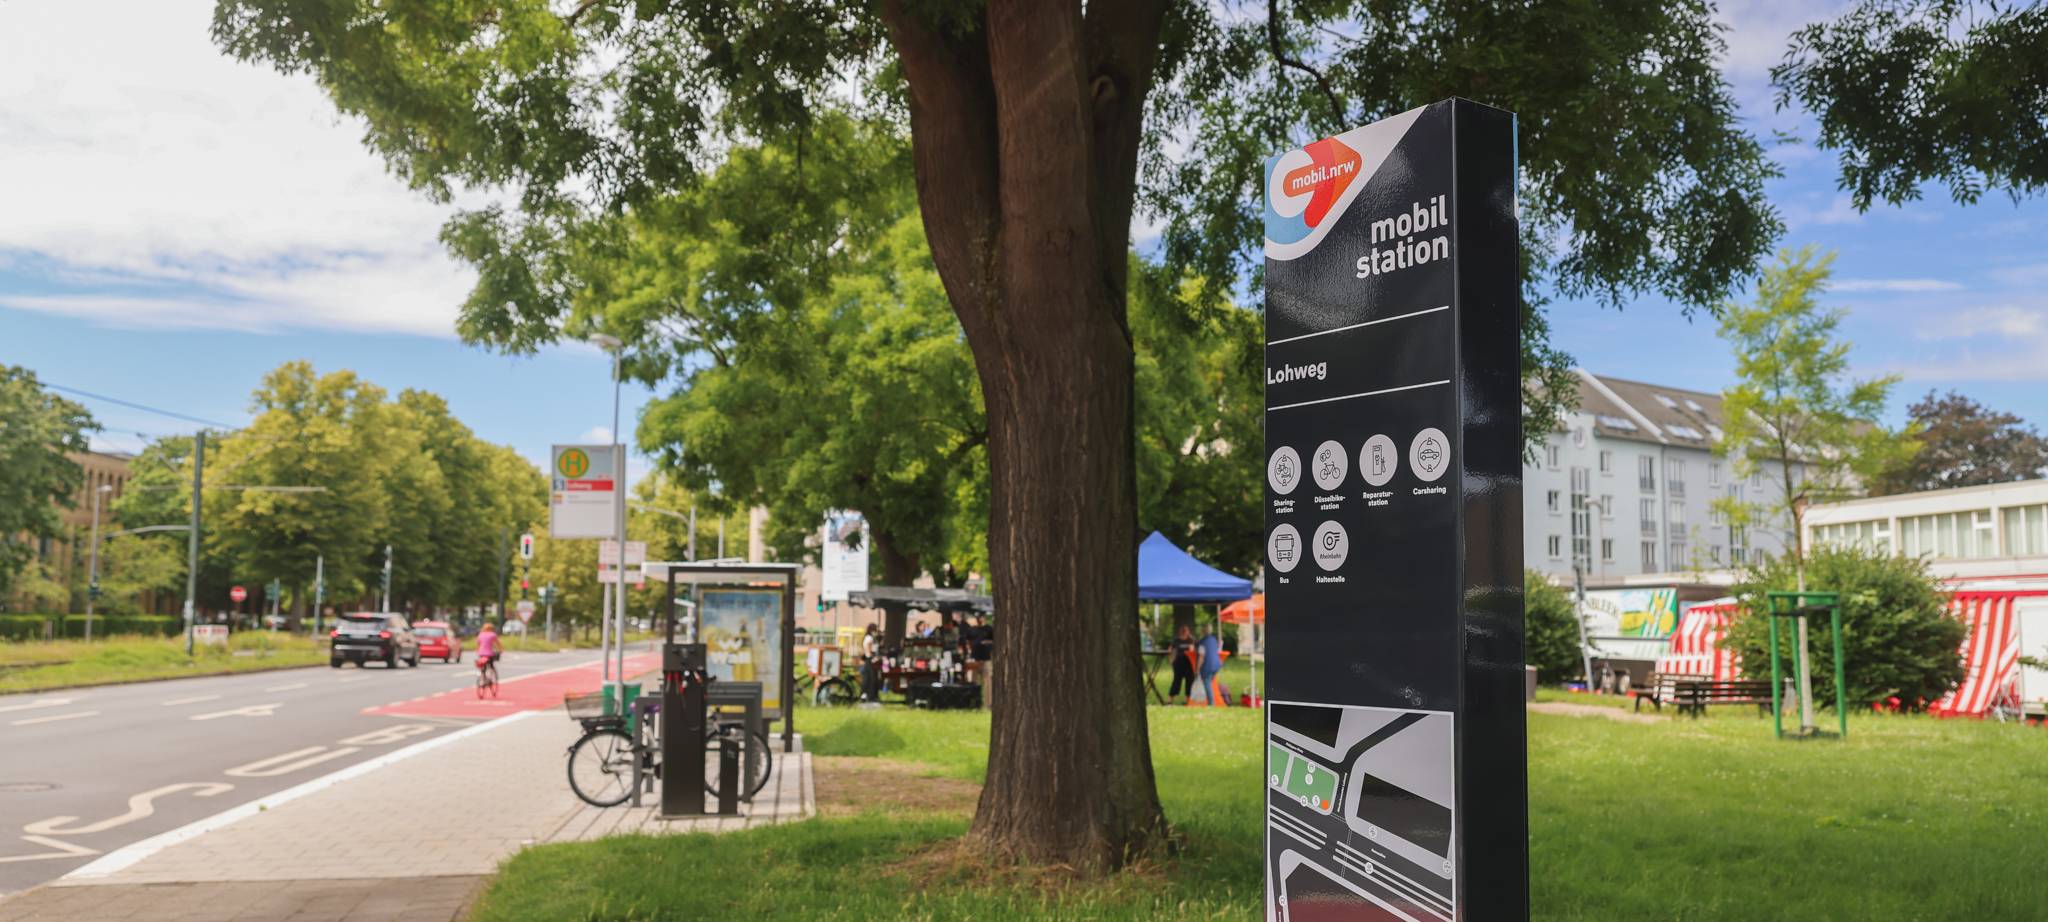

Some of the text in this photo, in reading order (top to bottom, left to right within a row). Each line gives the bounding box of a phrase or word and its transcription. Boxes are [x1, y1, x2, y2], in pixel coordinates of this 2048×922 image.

[1292, 160, 1355, 190] mobil.nrw
[1371, 194, 1448, 245] mobil
[1356, 236, 1449, 279] station
[1267, 361, 1327, 385] Lohweg
[565, 454, 582, 473] H
[1412, 486, 1447, 495] Carsharing
[1314, 495, 1346, 503] Düsselbike-
[1362, 491, 1394, 500] Reparatur-
[1273, 499, 1296, 507] Sharing-
[1320, 503, 1340, 511] station
[1367, 499, 1389, 507] station
[1279, 576, 1290, 584] Bus
[1315, 575, 1346, 583] Haltestelle
